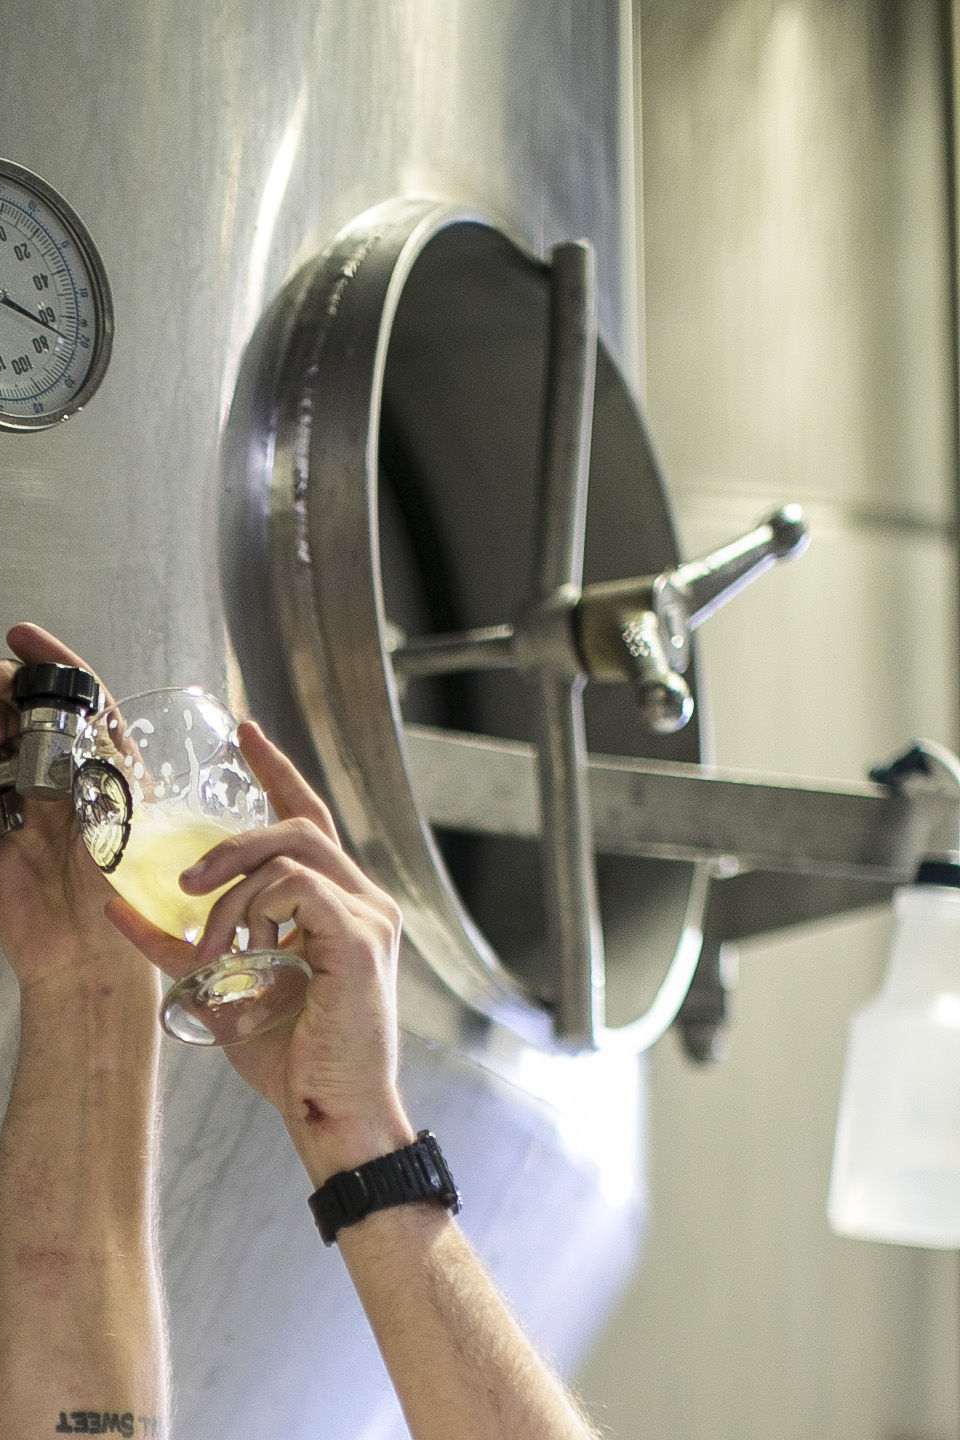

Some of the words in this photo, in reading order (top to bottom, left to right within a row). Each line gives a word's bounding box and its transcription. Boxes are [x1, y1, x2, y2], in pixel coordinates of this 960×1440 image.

[13, 243, 31, 261] 20
[32, 273, 48, 291] 40
[80, 288, 89, 298] 10
[38, 307, 56, 324] 60
[32, 335, 49, 353] 80
[11, 354, 33, 375] 100
[55, 1411, 134, 1438] SWEET
